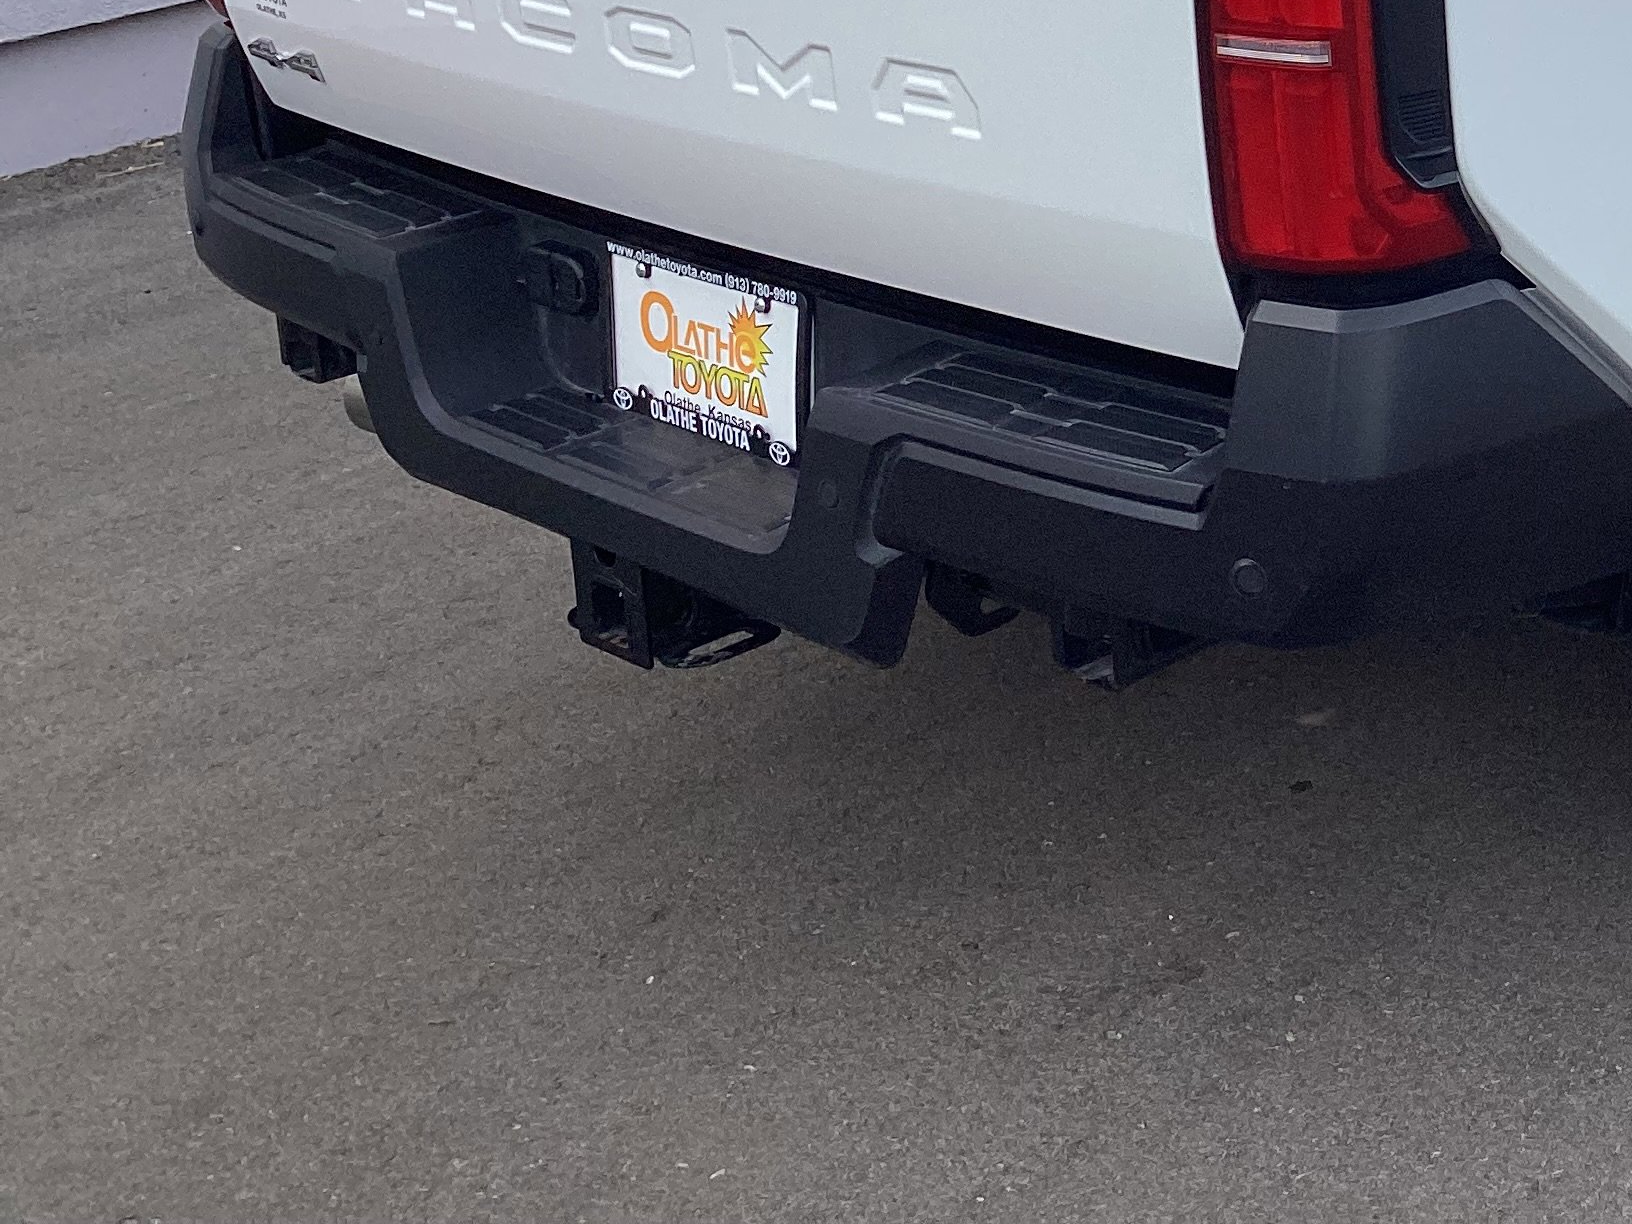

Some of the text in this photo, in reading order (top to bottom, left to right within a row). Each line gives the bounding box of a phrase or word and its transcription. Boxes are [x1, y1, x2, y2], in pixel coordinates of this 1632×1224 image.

[606, 240, 797, 306] www.olathetoyota.com (913) 780-9919
[667, 350, 769, 418] TOYOTA
[650, 398, 751, 452] OLATHE TOYOTA
